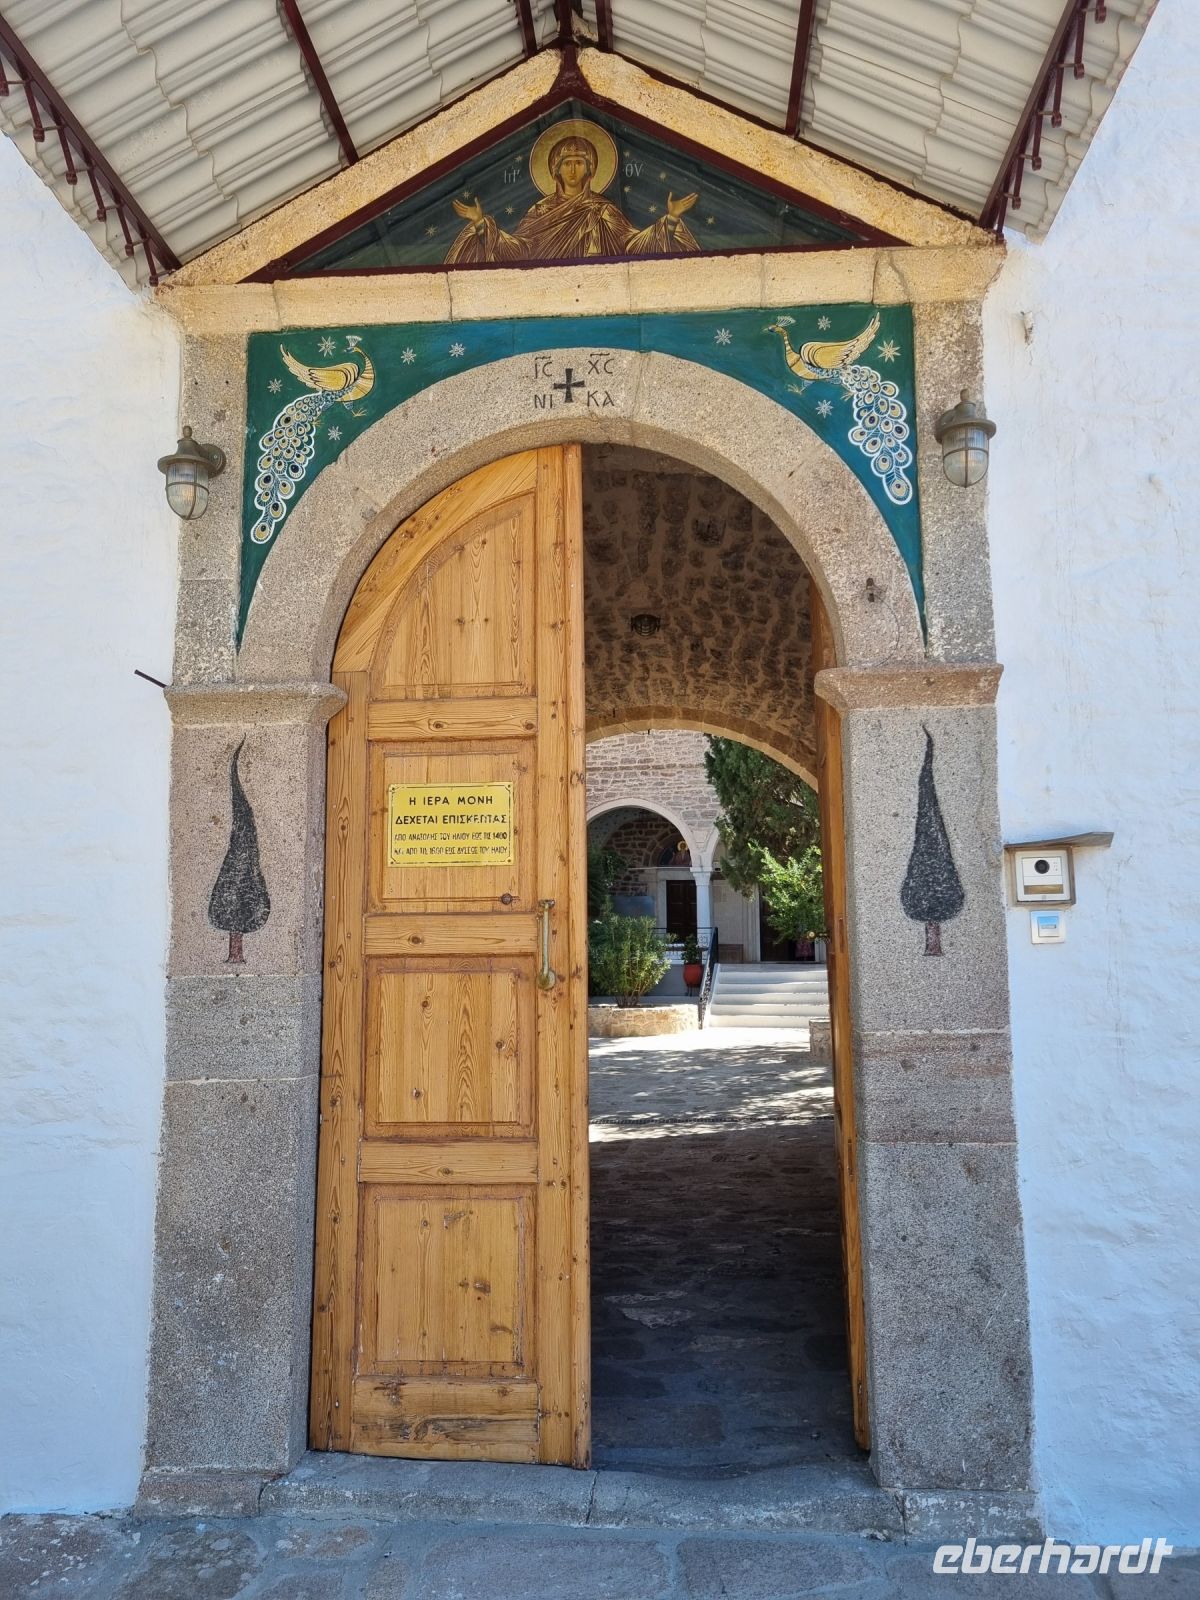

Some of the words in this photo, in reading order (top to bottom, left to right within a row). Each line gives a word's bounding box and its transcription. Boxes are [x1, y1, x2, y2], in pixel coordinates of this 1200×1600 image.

[409, 797, 416, 806] Η
[423, 796, 450, 806] ΙΕΡΑ
[457, 795, 493, 805] ΜΟΝΗ
[395, 815, 438, 825] ΔΕΧΕΤΑΙ
[442, 814, 507, 824] ΕΠΙΣΚΕΠΤΑΣ
[439, 832, 450, 840] ΤΟΥ
